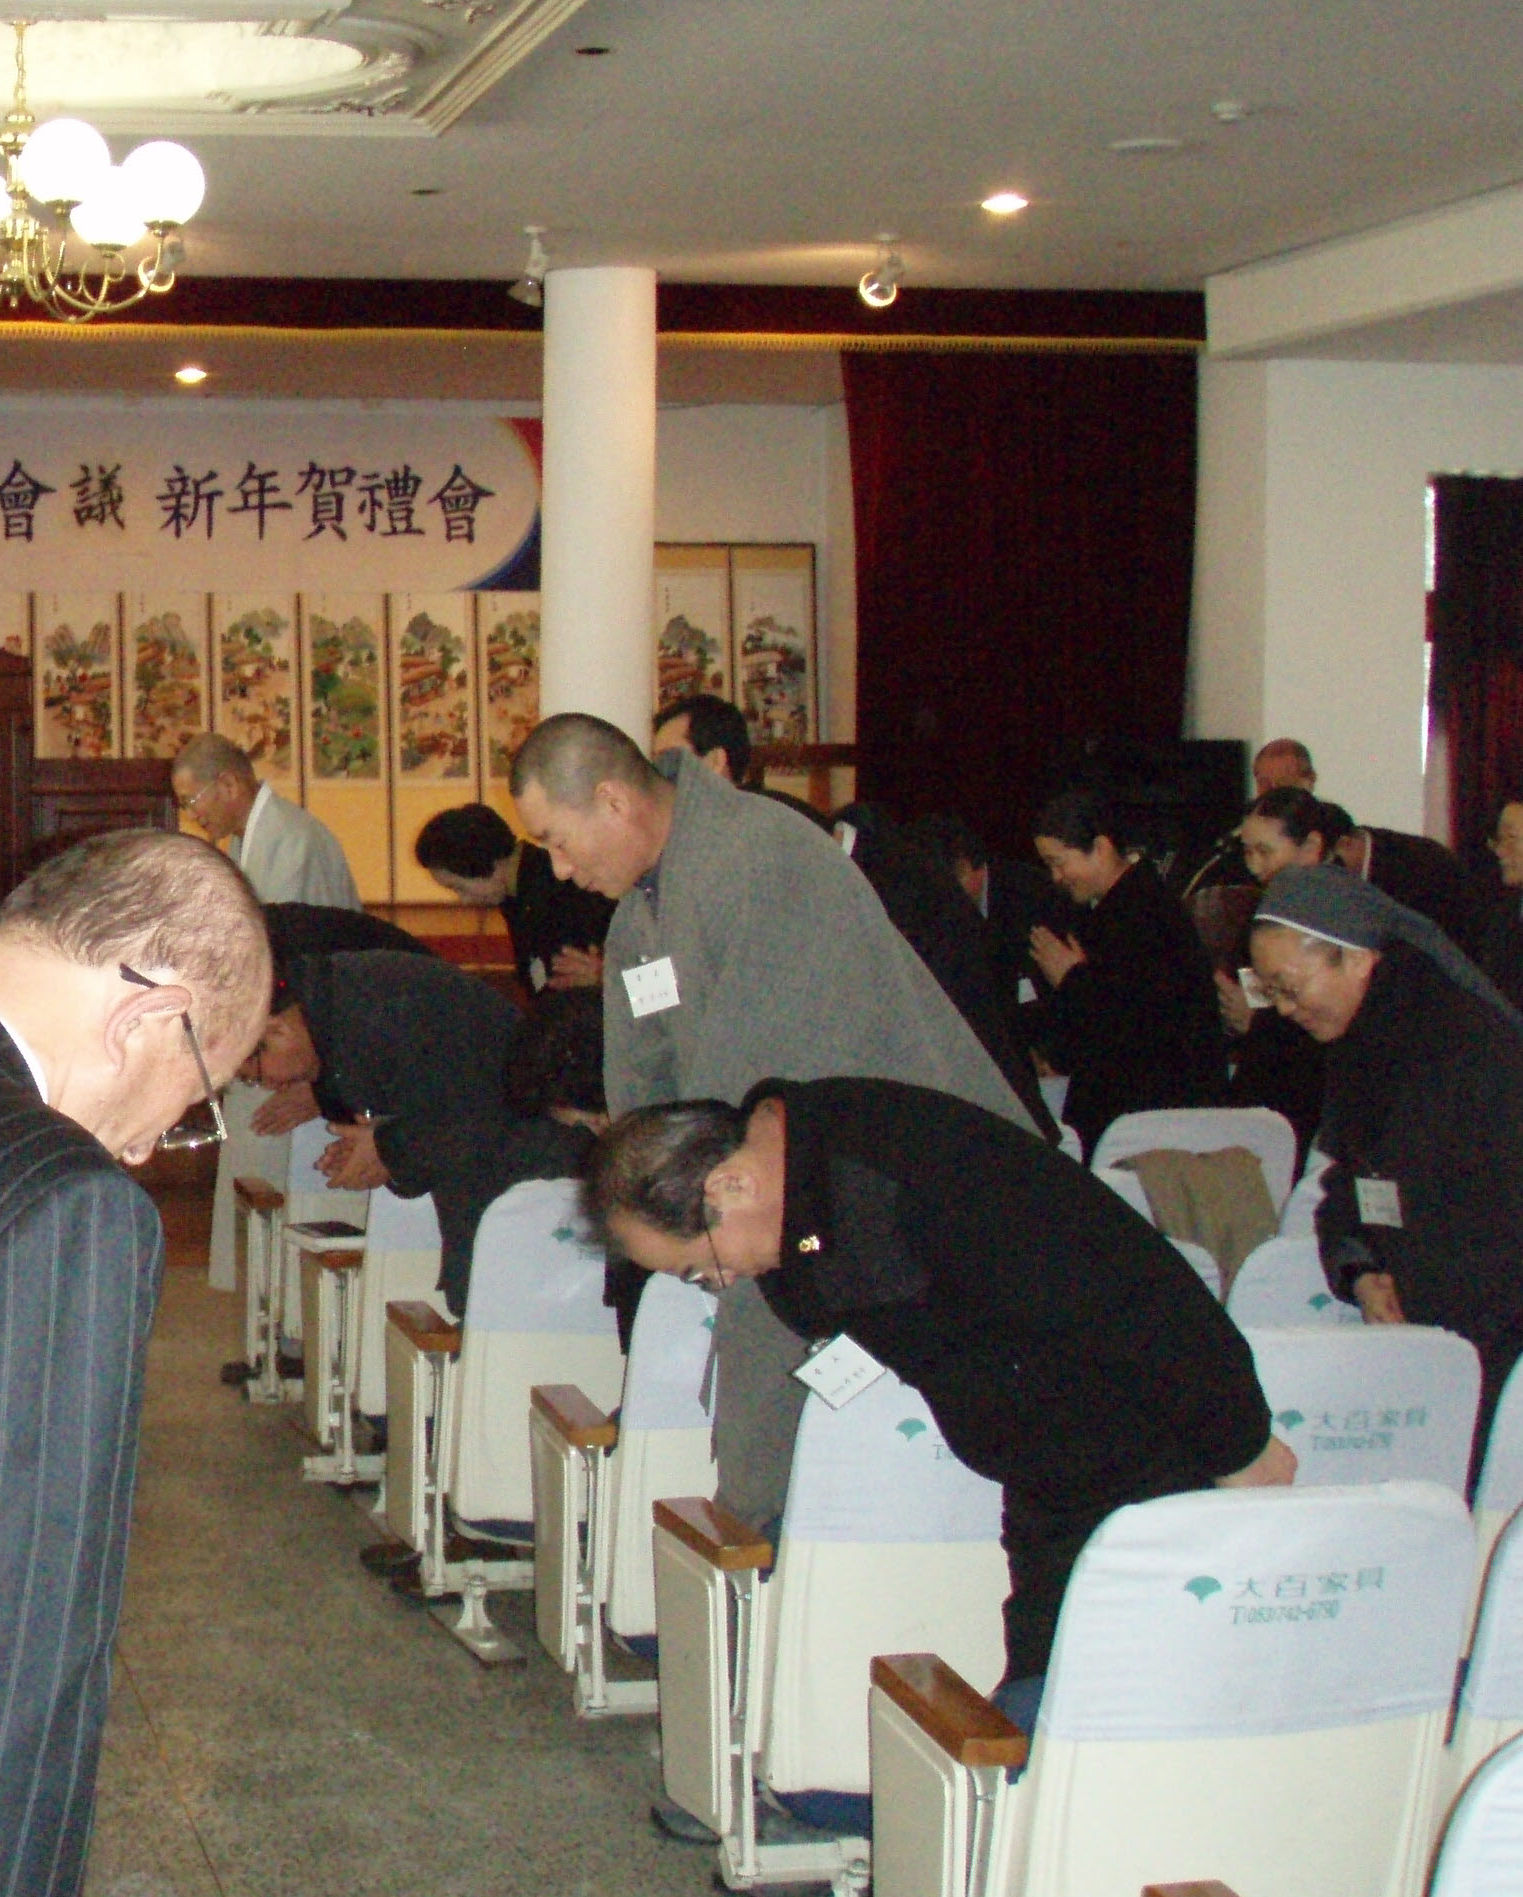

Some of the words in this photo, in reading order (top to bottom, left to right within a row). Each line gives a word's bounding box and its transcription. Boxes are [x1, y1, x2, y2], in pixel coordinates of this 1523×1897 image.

[155, 461, 496, 544] 新年賀禮會
